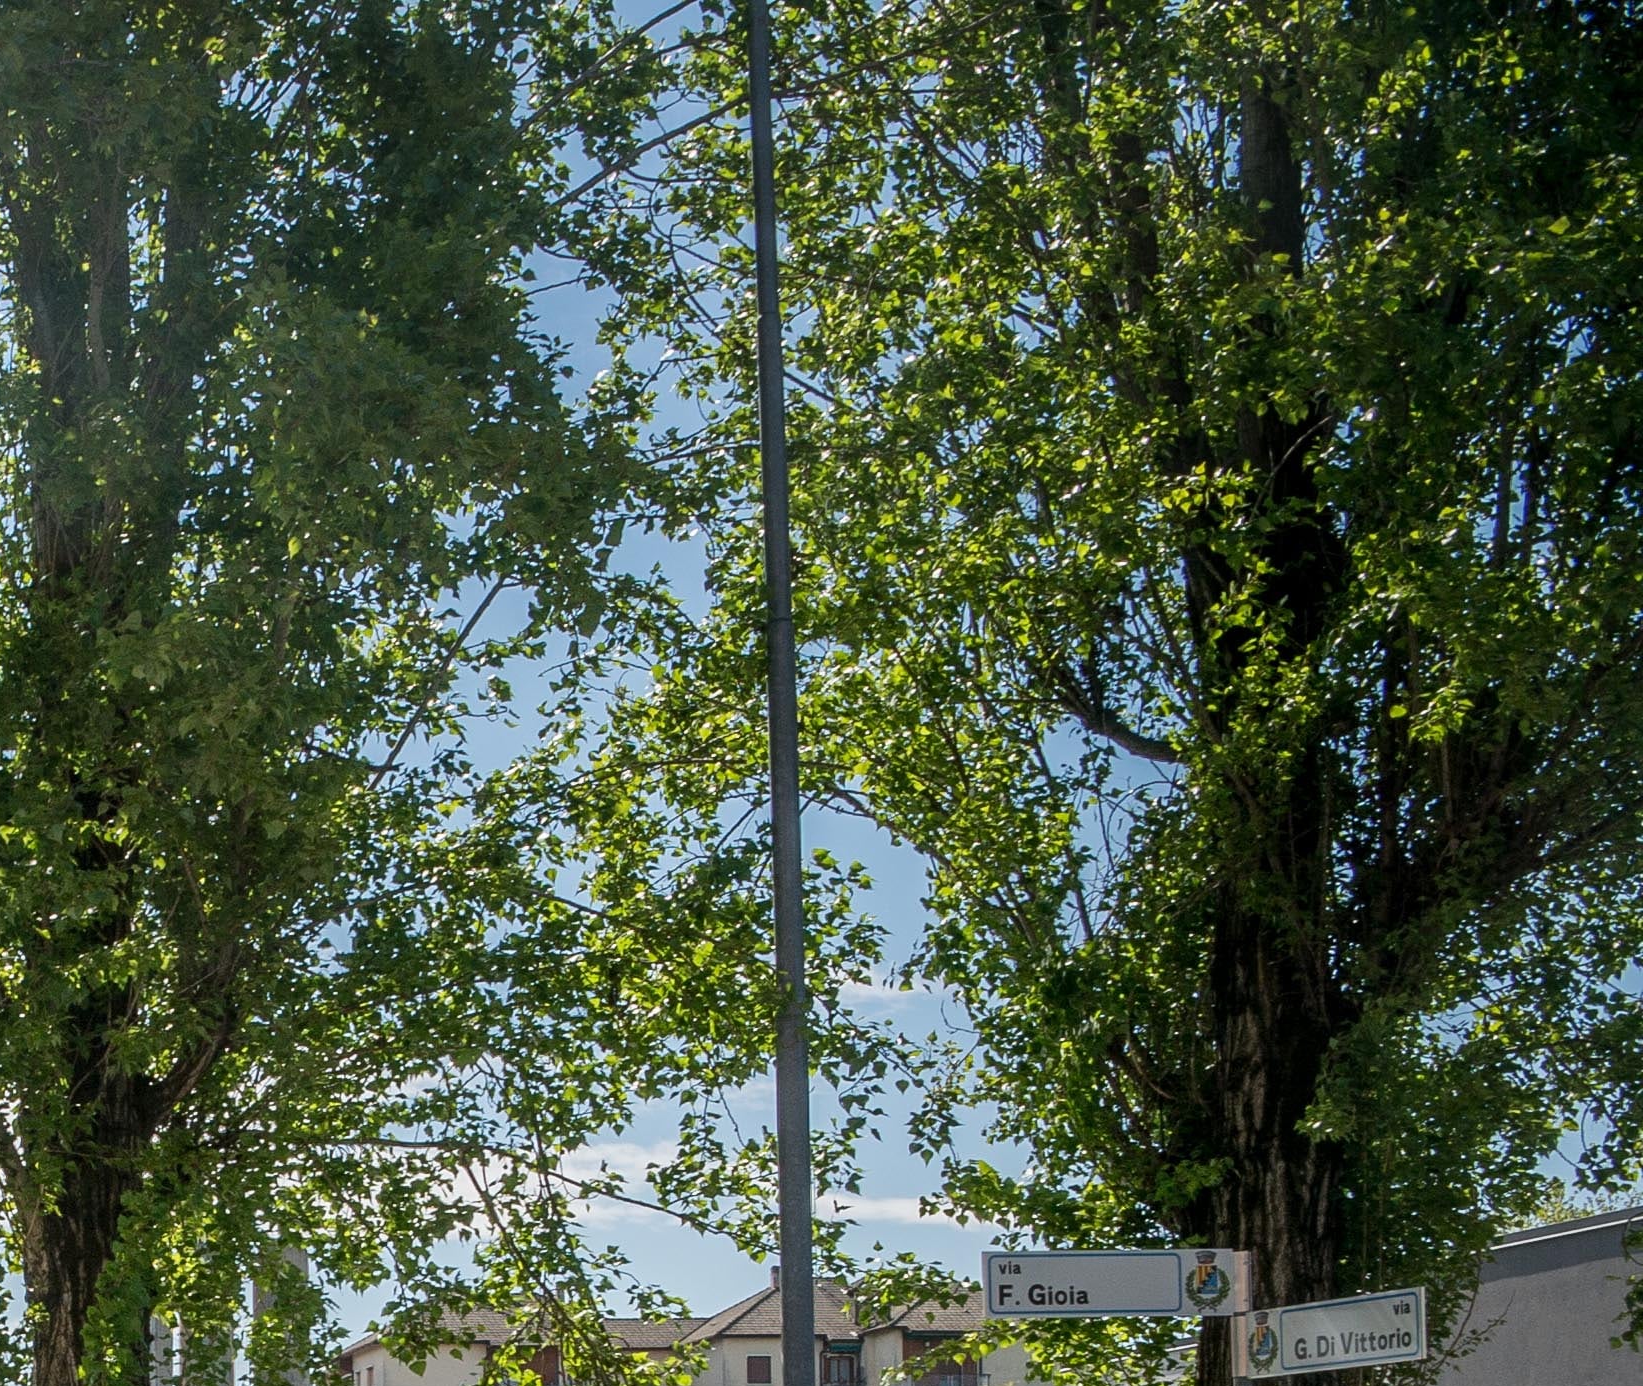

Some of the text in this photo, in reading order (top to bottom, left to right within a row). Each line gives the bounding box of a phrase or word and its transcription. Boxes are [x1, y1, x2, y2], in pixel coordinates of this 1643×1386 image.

[998, 1261, 1021, 1274] via
[998, 1284, 1089, 1306] F. Gioia
[1392, 1301, 1411, 1315] via
[1295, 1328, 1412, 1360] G. Di Vittorio
